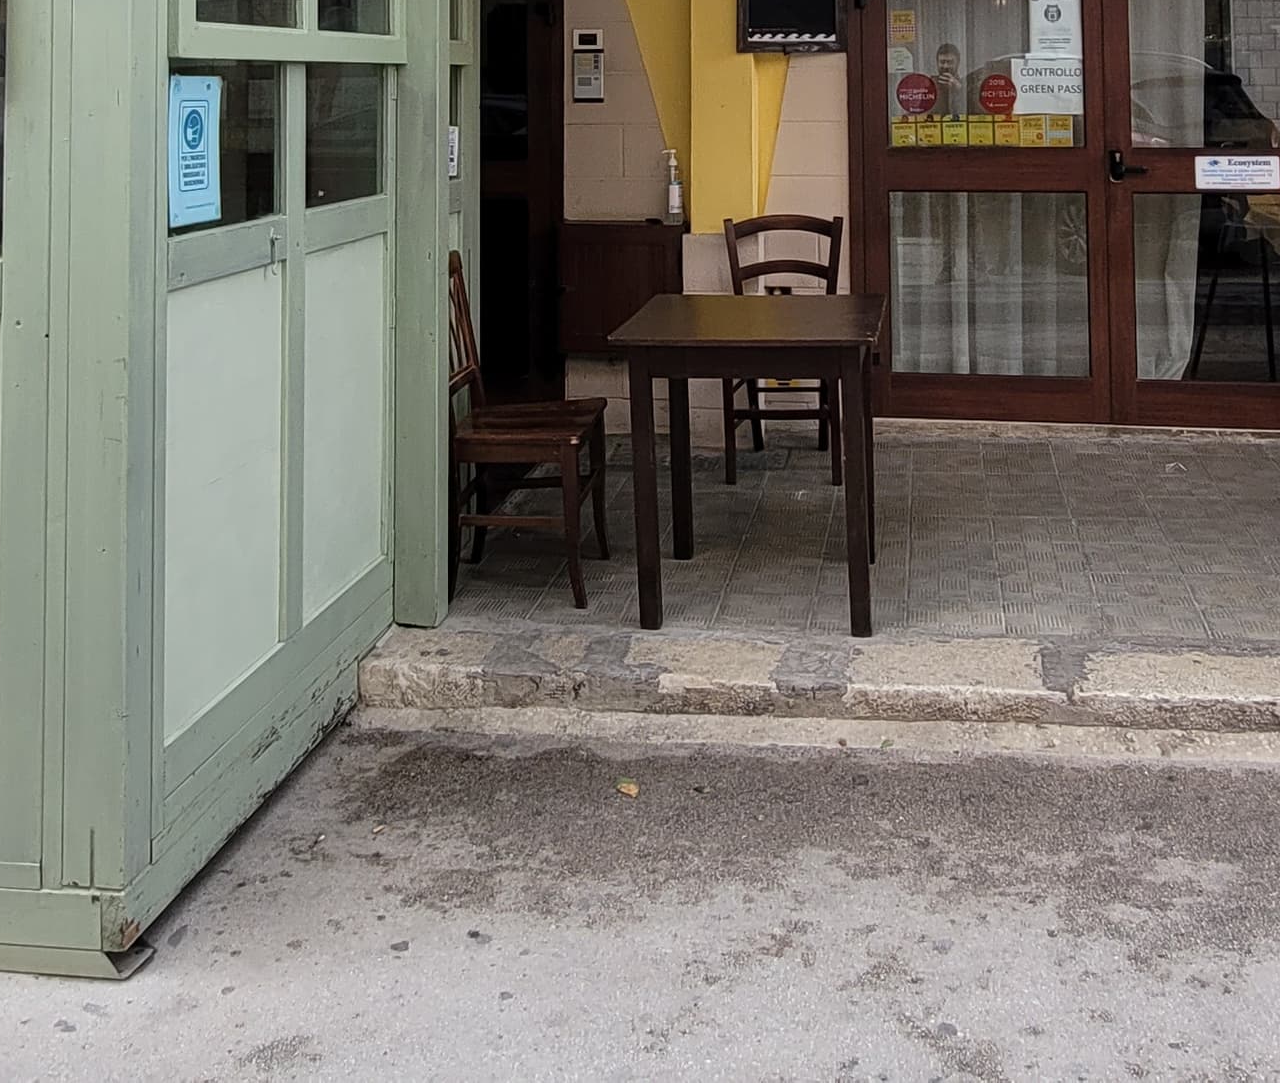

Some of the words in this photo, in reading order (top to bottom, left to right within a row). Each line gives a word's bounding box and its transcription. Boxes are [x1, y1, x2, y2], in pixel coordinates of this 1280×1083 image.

[1020, 67, 1082, 78] CONTROLLO
[1020, 84, 1055, 94] GREEN
[1057, 84, 1082, 94] PASS
[1227, 158, 1271, 168] Ecosystem
